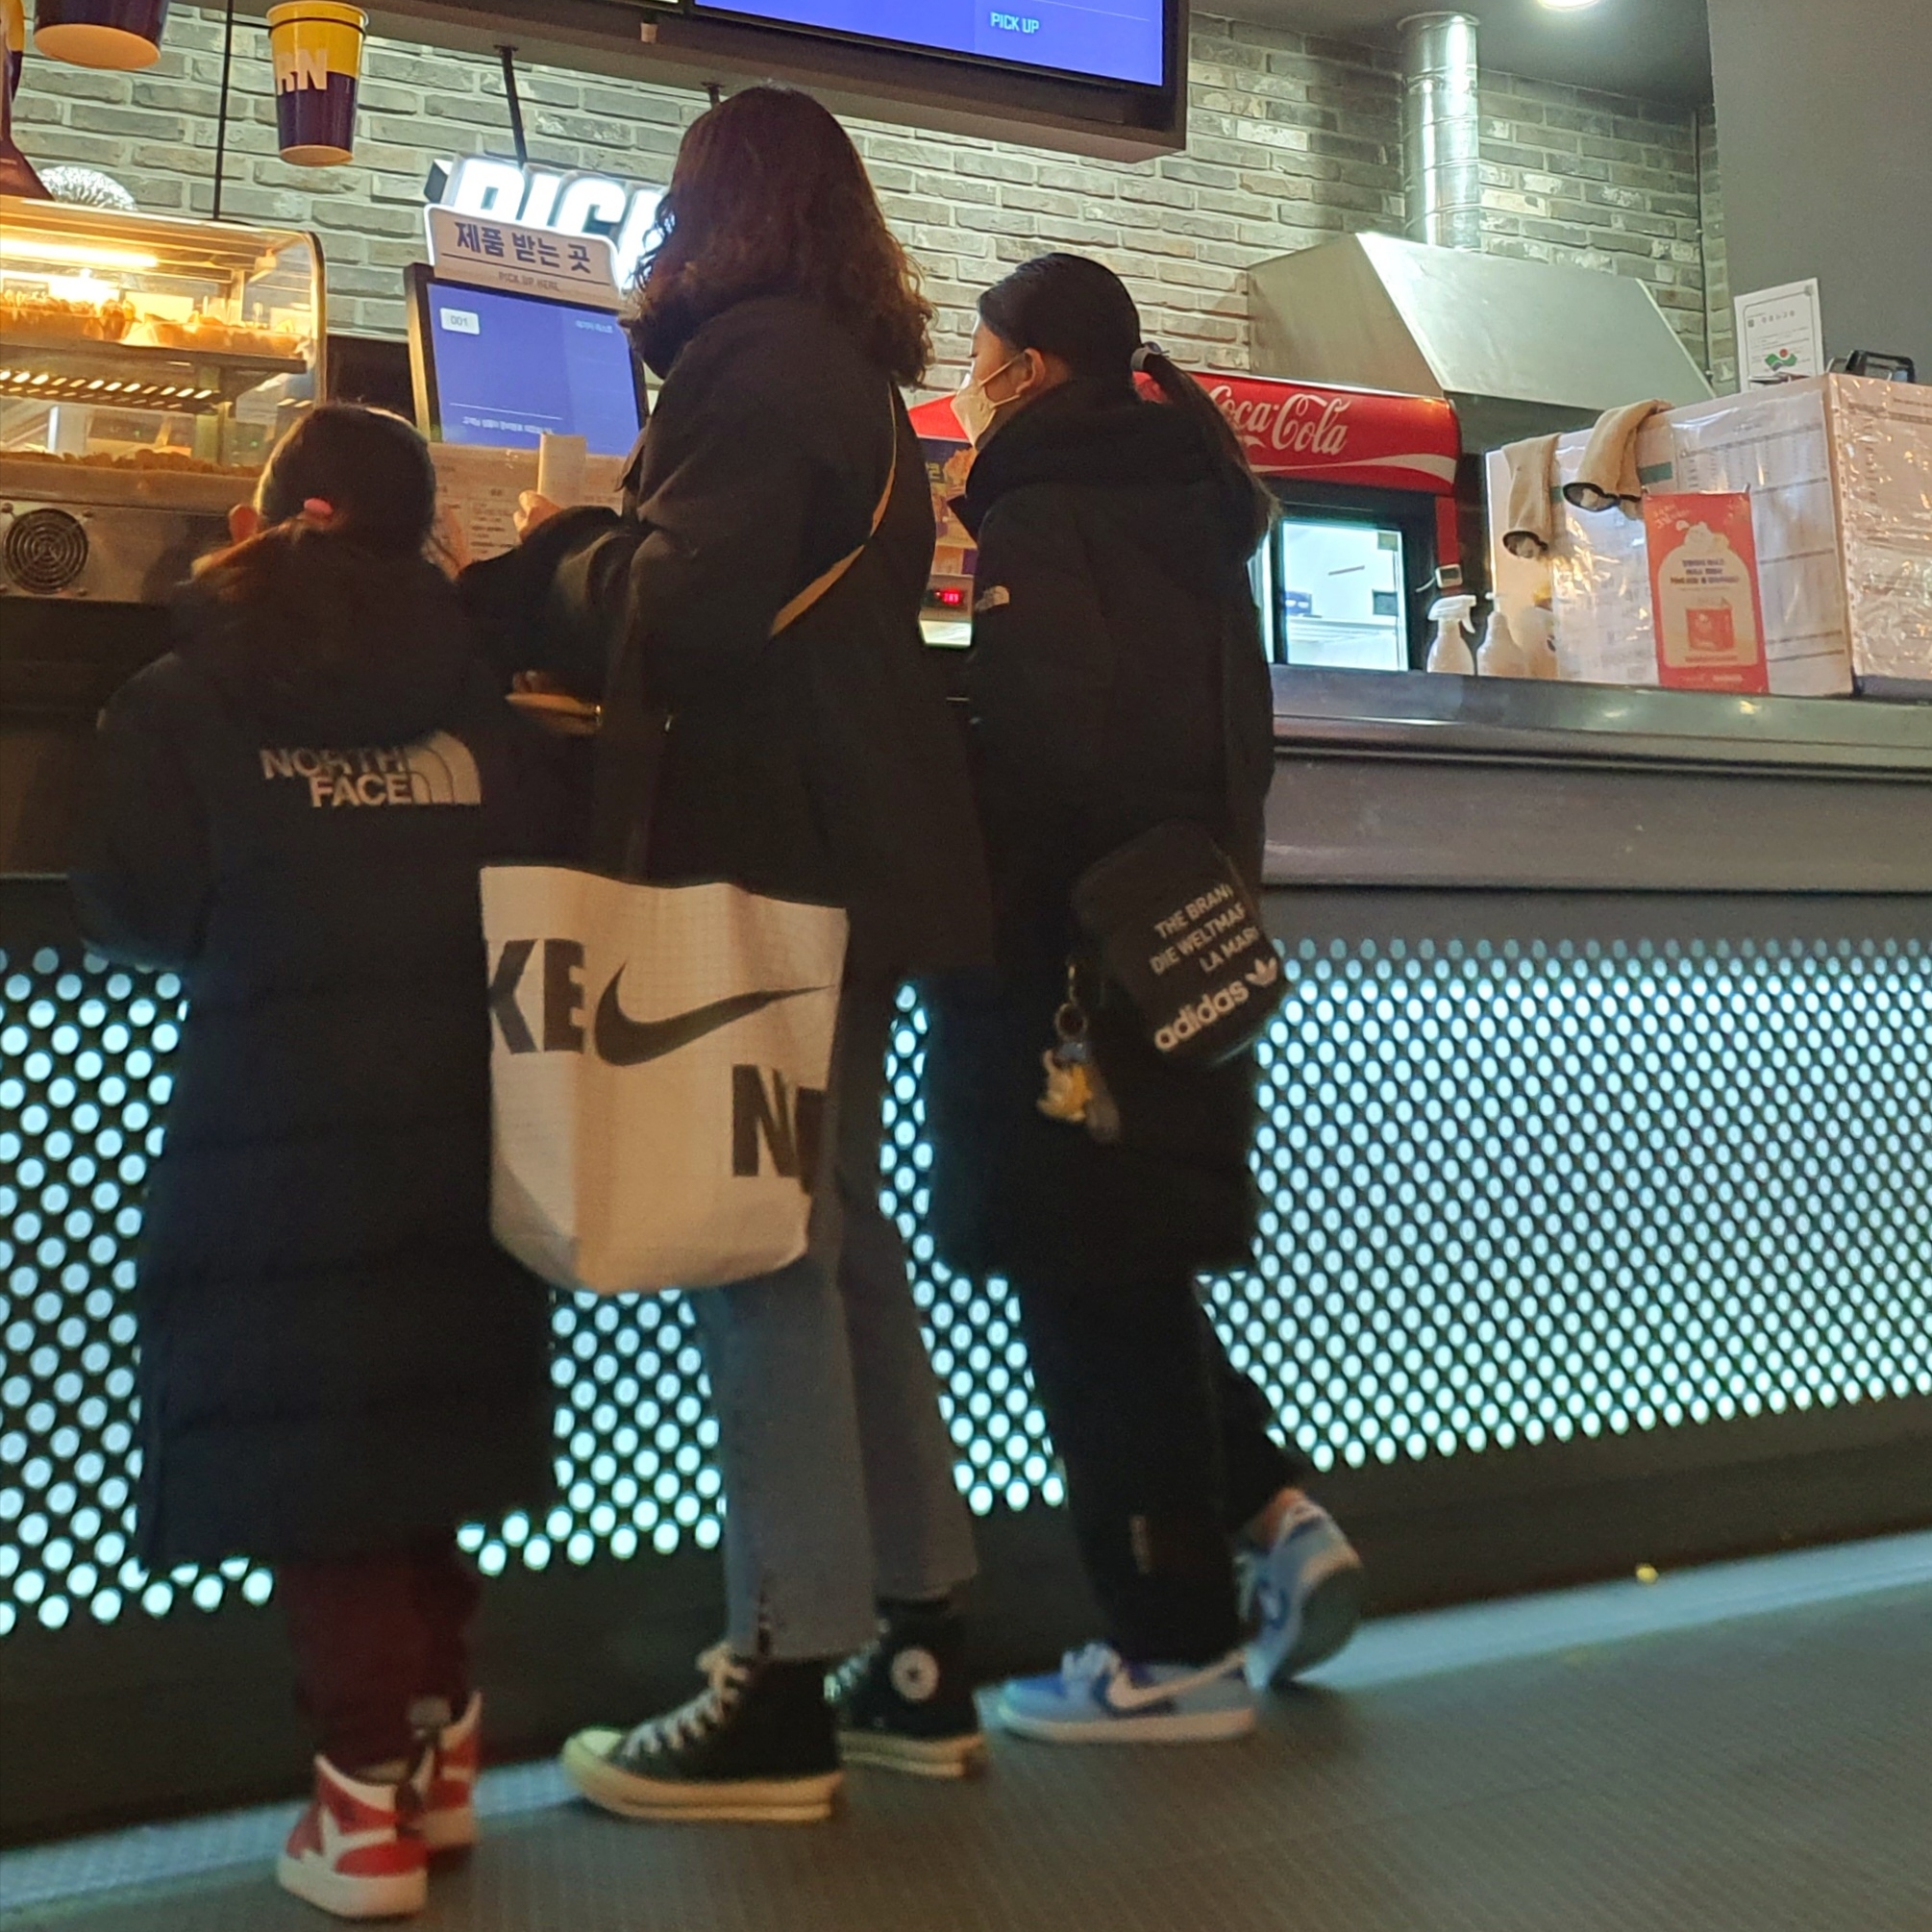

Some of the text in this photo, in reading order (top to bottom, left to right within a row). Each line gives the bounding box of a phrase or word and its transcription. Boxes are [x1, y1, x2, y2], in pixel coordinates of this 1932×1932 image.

[990, 12, 1039, 34] PICK UP
[454, 221, 591, 274] 제품 받는 곳
[498, 271, 520, 284] PICK
[522, 275, 534, 285] UP
[450, 314, 469, 327] 001
[260, 746, 408, 780] NORTH
[309, 772, 412, 808] FACE
[1154, 909, 1188, 939] THE
[1150, 947, 1179, 976] DIE
[1200, 951, 1225, 974] LA
[1154, 979, 1250, 1053] adidas
